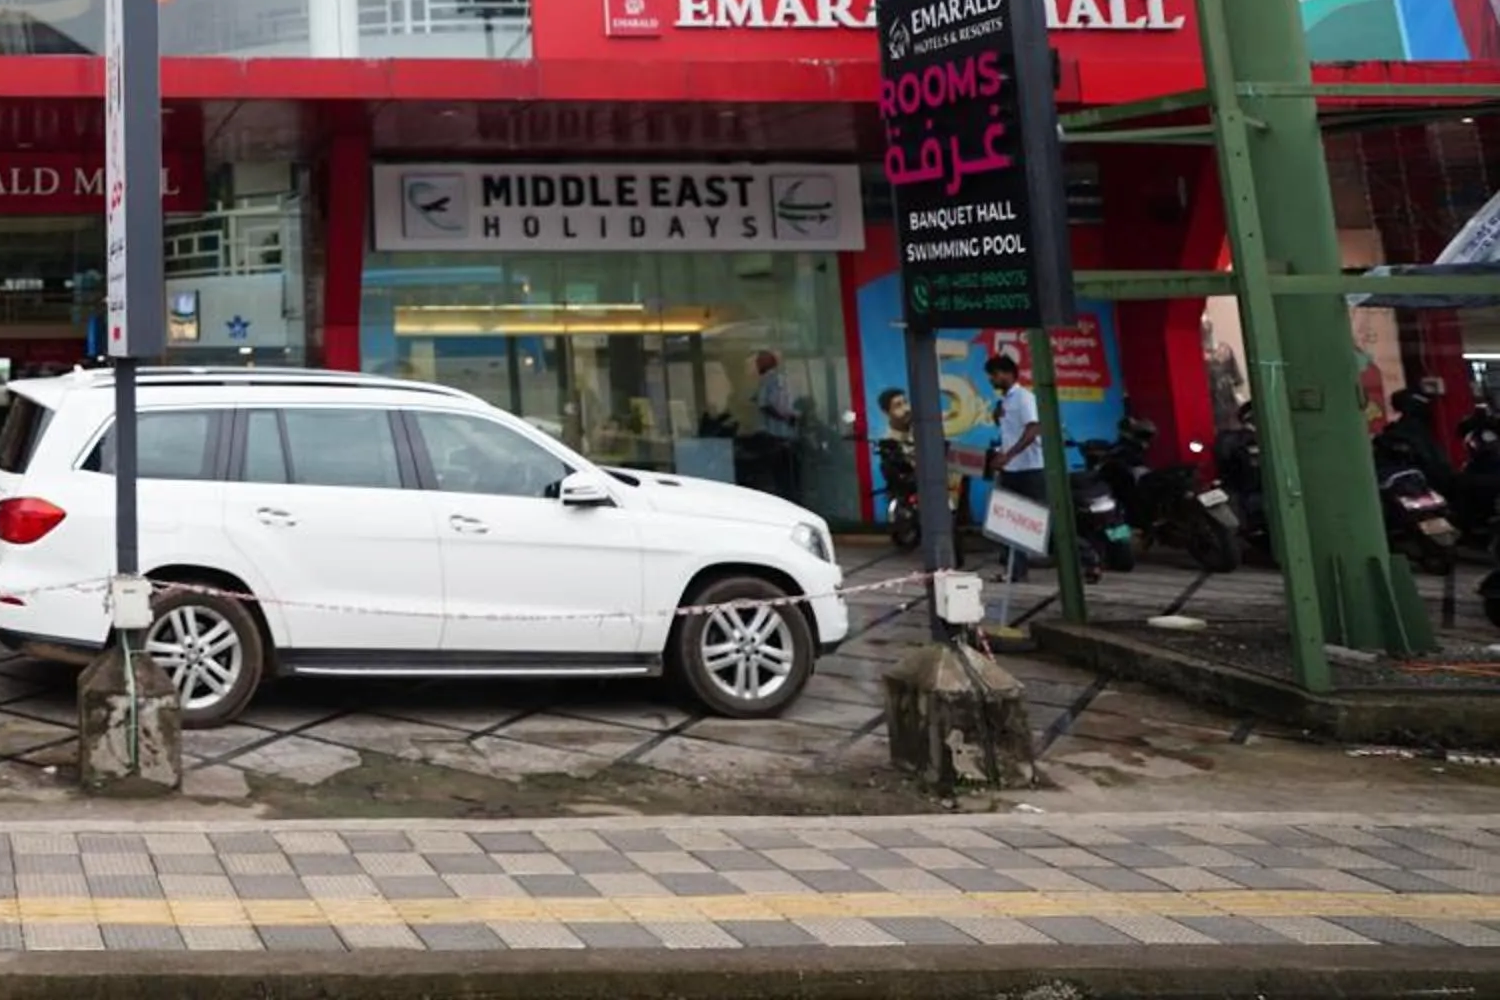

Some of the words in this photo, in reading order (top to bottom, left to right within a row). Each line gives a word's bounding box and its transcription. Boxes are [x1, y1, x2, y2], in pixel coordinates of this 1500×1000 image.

[913, 33, 950, 54] HOTELS
[959, 16, 1004, 43] RESORTS
[880, 51, 1003, 119] ROOMS
[885, 104, 1013, 195] غرفة
[74, 167, 181, 195] ML
[483, 176, 637, 208] MIDDLE
[650, 175, 754, 208] EAST
[483, 215, 759, 238] HOLIDAYS
[909, 204, 973, 231] BANQUET
[977, 200, 1017, 223] HALL
[906, 237, 980, 262] SWIMMING
[982, 233, 1026, 256] POOL
